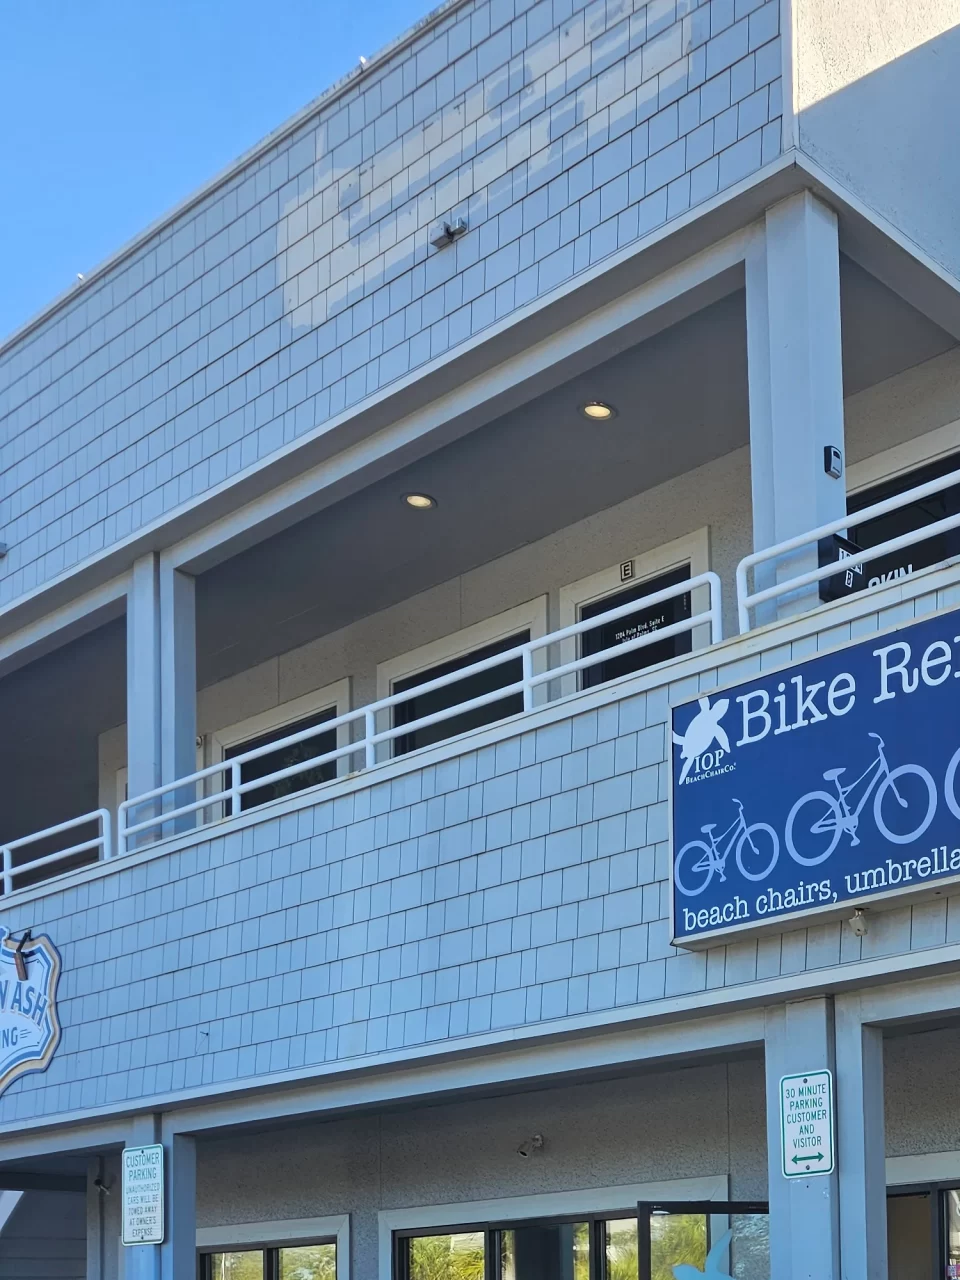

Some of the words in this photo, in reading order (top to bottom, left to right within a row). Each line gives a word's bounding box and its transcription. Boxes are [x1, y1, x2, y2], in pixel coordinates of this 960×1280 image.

[735, 670, 857, 747] Bike
[694, 748, 725, 774] IOP
[683, 896, 749, 932] beach
[756, 879, 838, 916] chairs,
[785, 1088, 796, 1099] 30
[798, 1083, 827, 1097] MINUTE
[789, 1097, 823, 1111] PARKING
[786, 1110, 827, 1124] CUSTOMER
[798, 1124, 815, 1136] AND
[792, 1135, 822, 1149] VISITOR
[126, 1152, 160, 1168] CUSTOMER
[128, 1168, 157, 1182] PARKING
